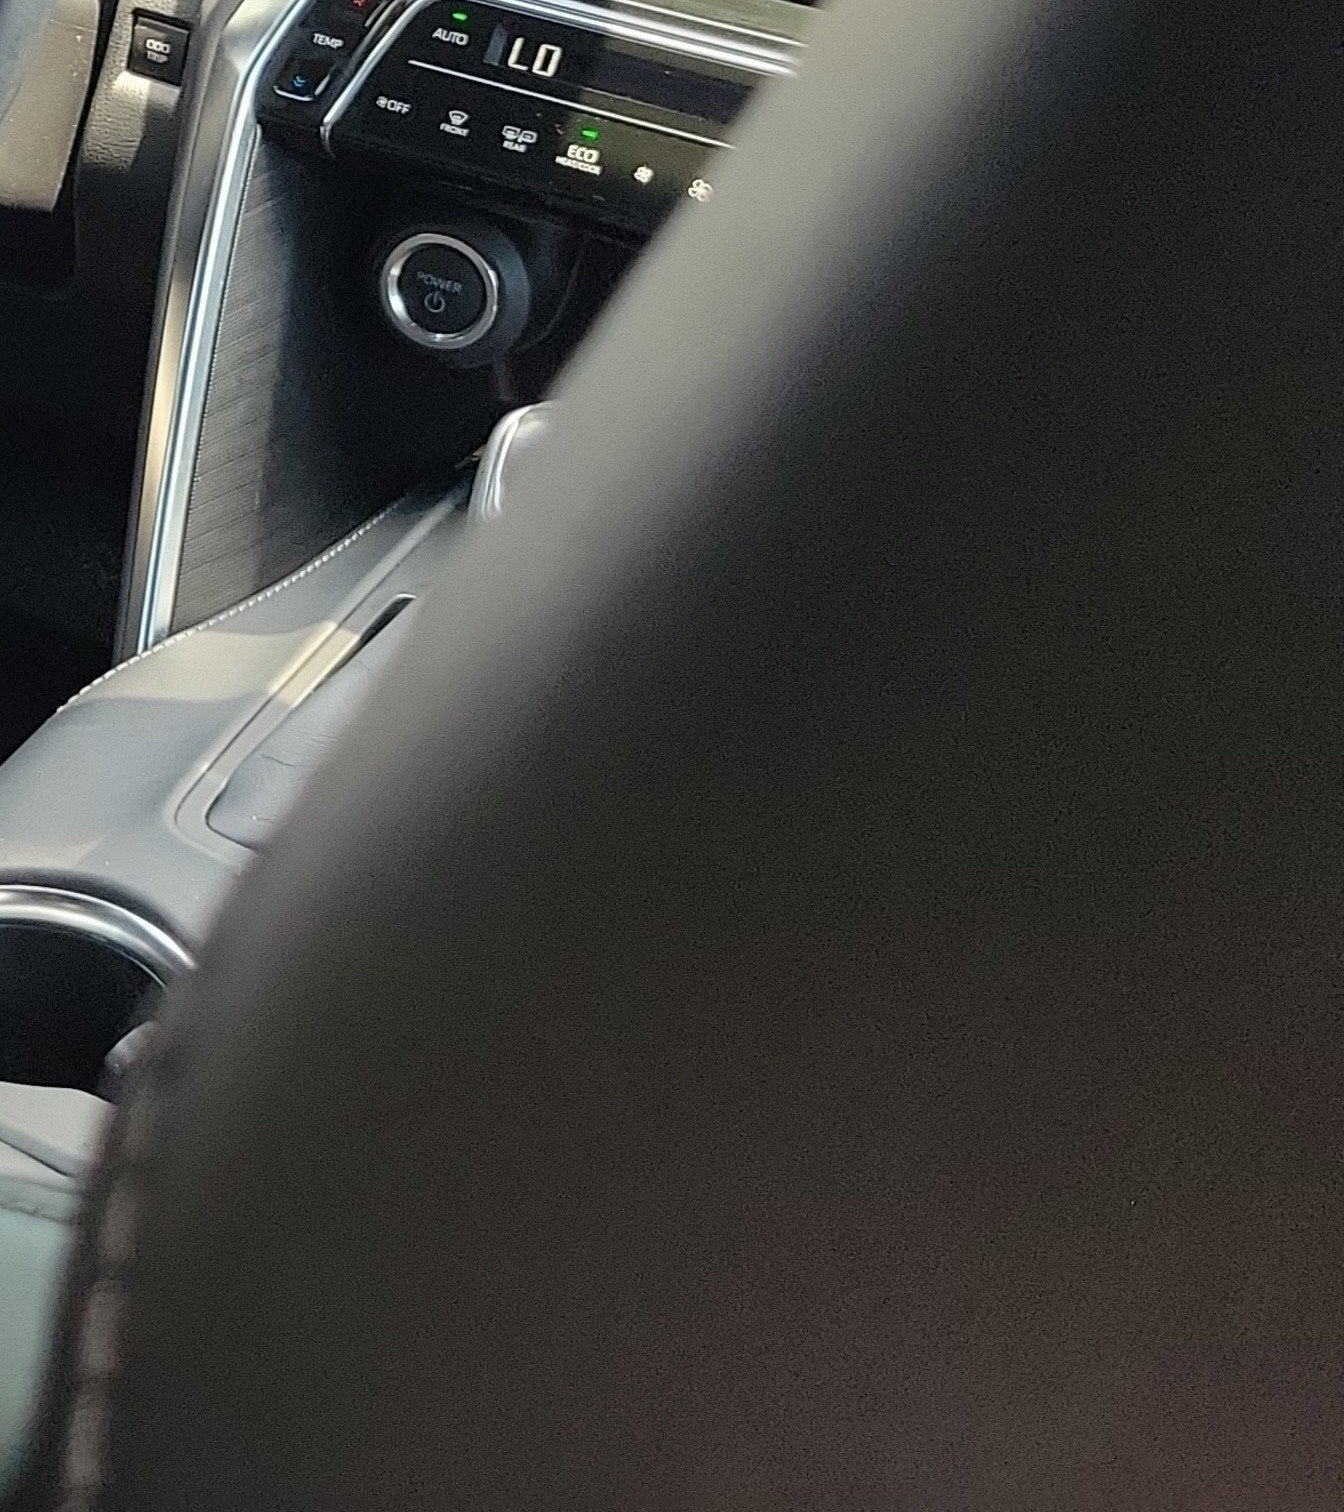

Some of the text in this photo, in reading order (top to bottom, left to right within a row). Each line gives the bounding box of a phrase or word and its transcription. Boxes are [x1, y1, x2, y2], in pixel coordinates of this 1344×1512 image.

[312, 32, 344, 50] TEMP
[432, 27, 469, 46] AUTO
[387, 98, 411, 115] OFF
[566, 144, 600, 164] ECO
